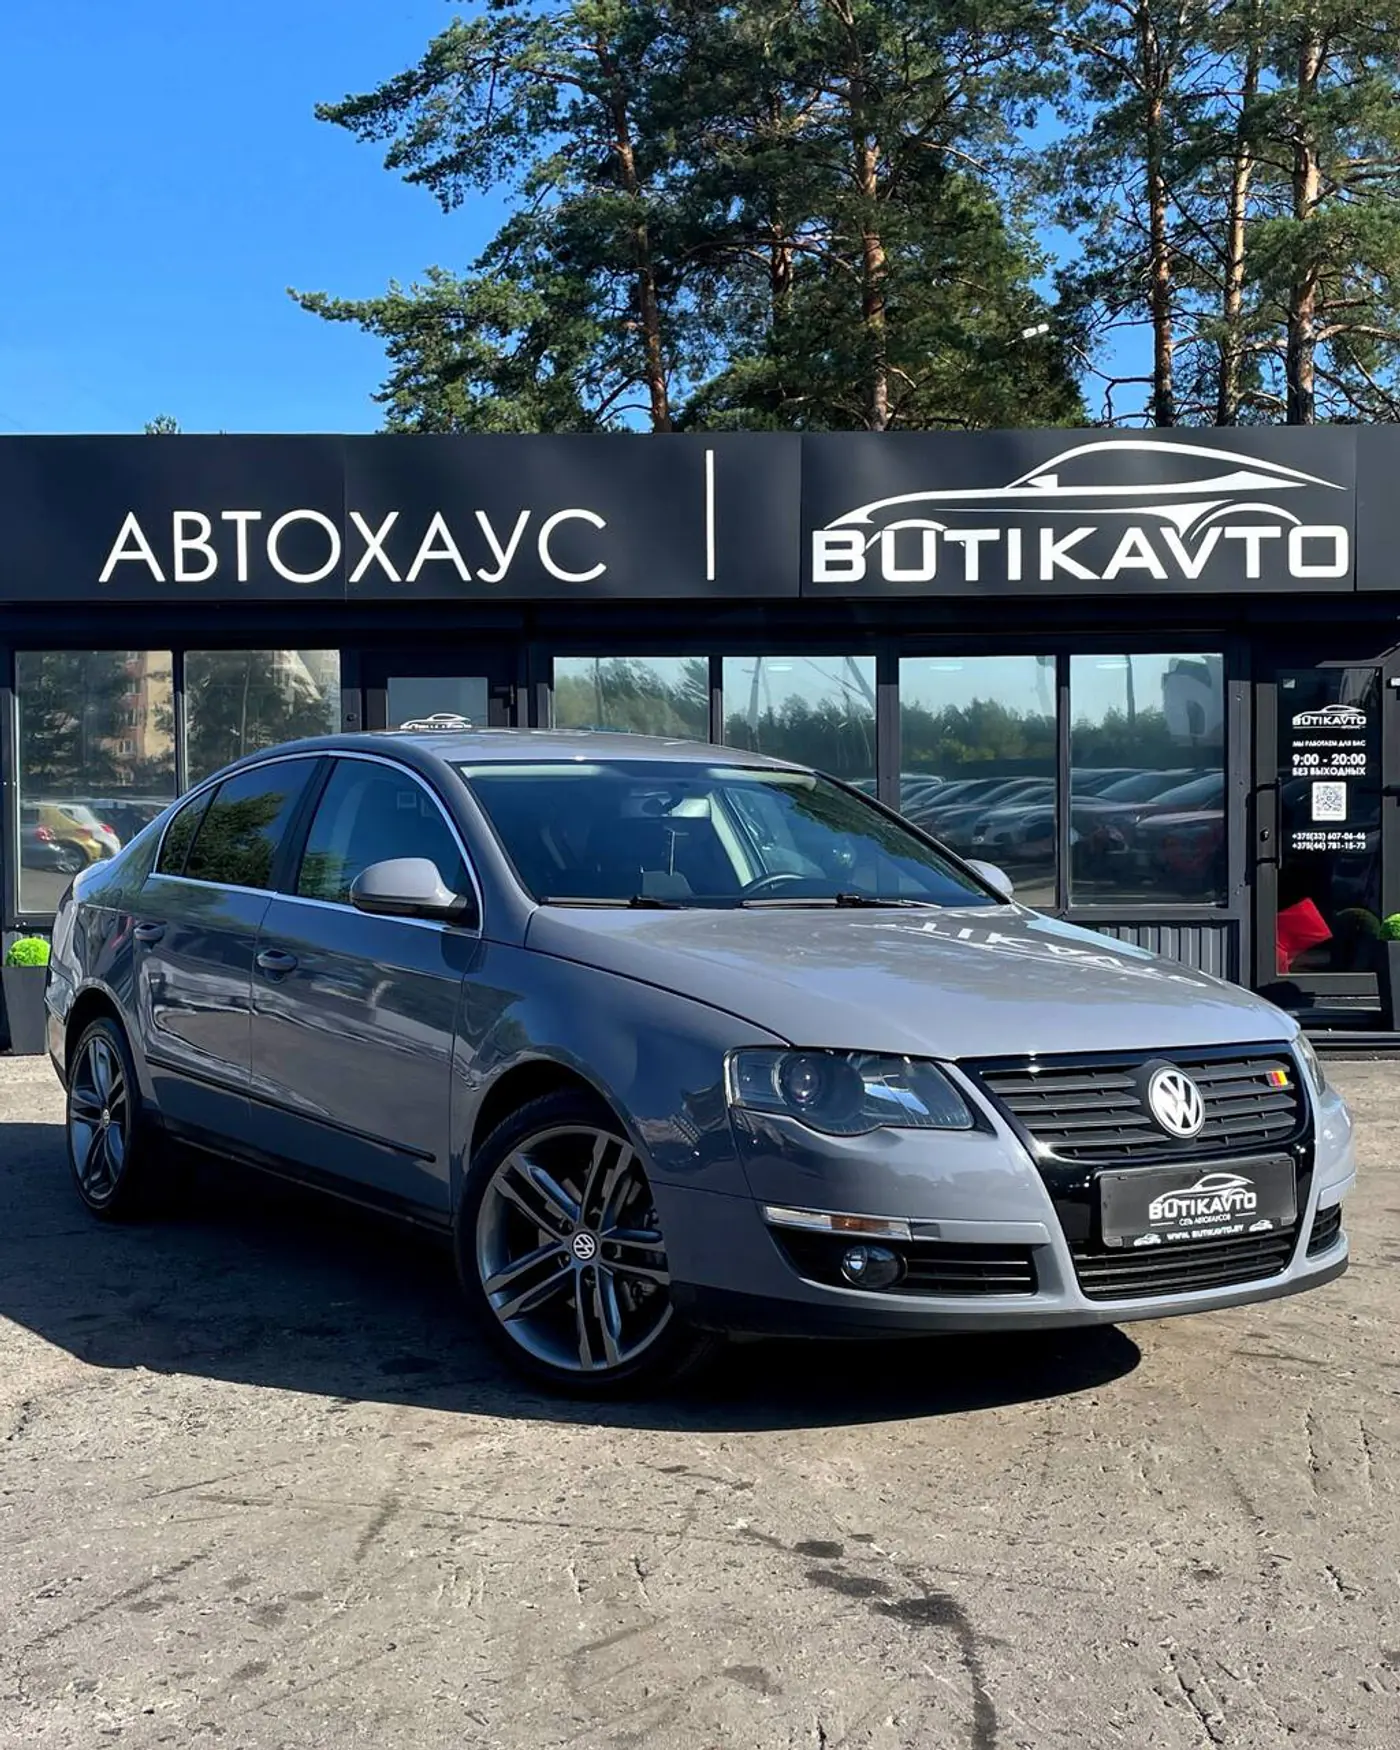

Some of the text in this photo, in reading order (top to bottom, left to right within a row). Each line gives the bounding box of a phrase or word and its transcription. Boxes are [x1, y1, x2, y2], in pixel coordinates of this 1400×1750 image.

[99, 508, 607, 583] АВТОХАУС
[812, 525, 1349, 583] BUTIKAVTO
[1292, 715, 1367, 726] BUTIKAVTO
[1292, 753, 1319, 766] 9:00
[1331, 753, 1367, 766] 20:00
[1292, 767, 1366, 777] БЕЗ ВЫХОДНЫХ
[1148, 1192, 1257, 1220] BUTIKAVTO
